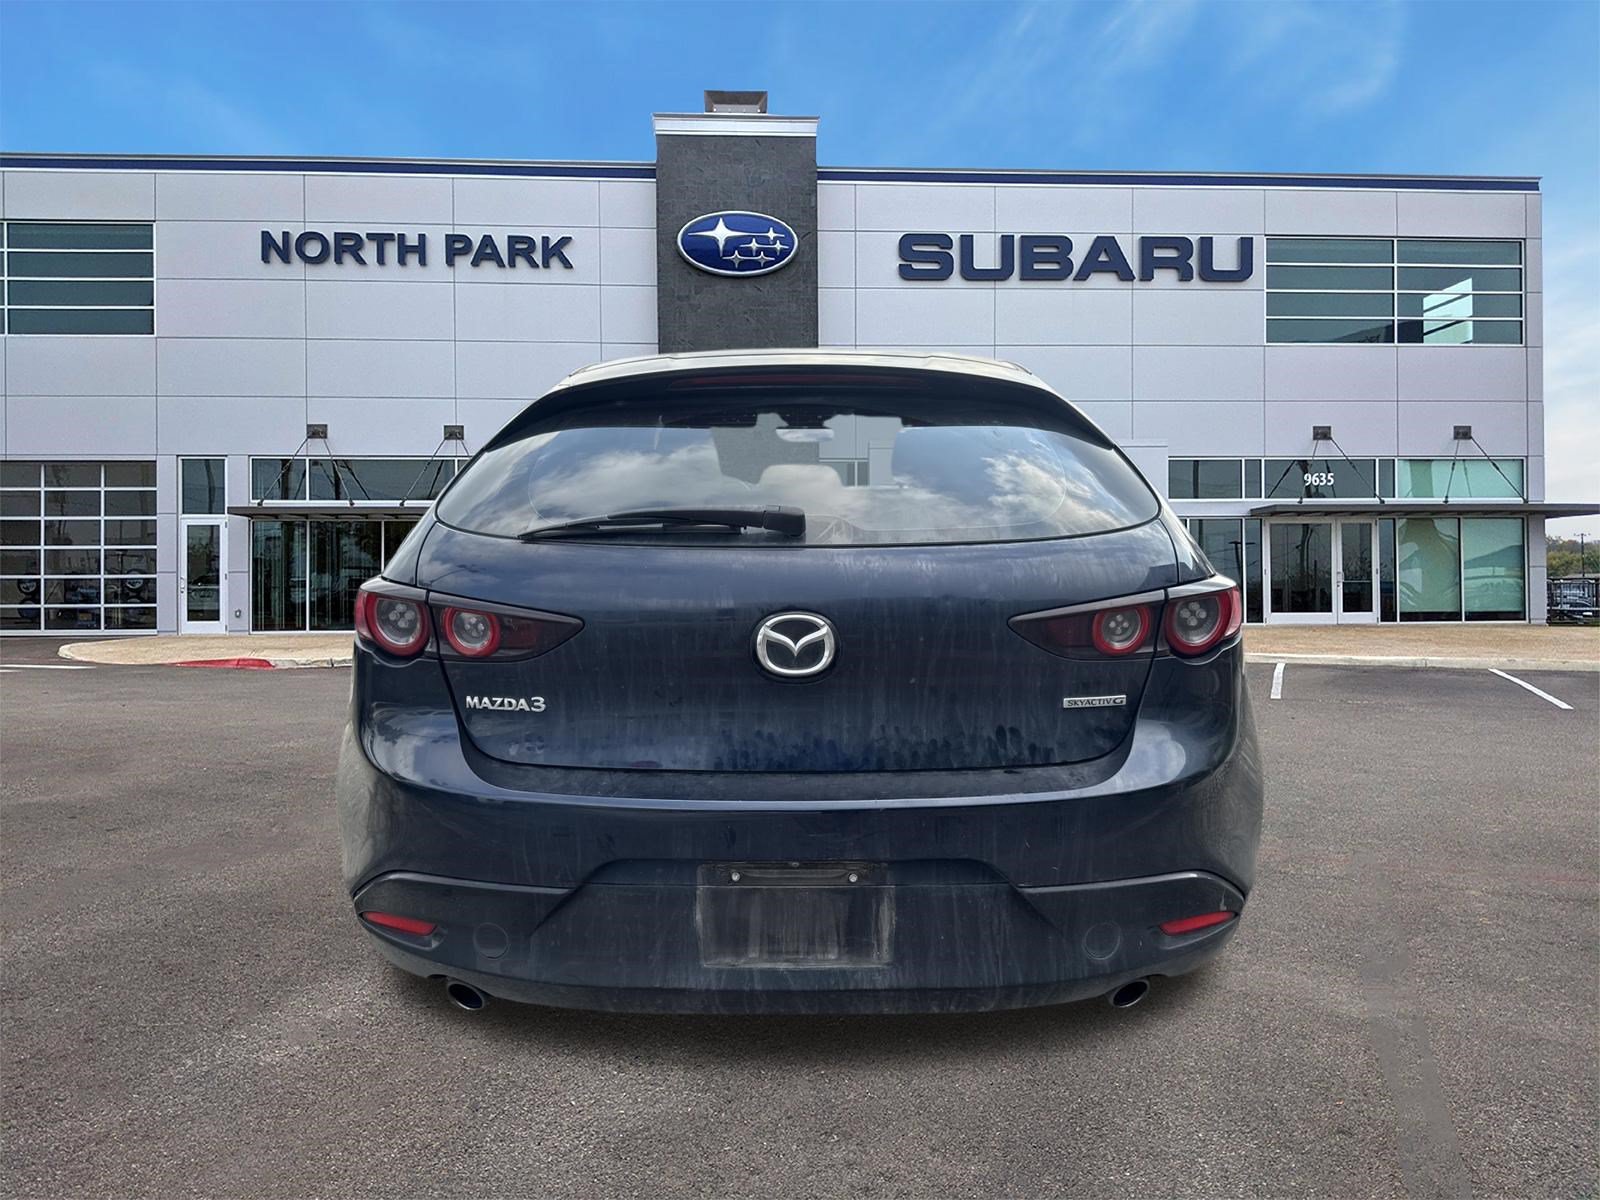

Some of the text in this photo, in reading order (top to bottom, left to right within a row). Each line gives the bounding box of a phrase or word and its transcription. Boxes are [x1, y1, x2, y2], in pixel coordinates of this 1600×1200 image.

[260, 230, 574, 269] NORTH PARK
[898, 233, 1254, 282] SUBARU
[1303, 472, 1335, 486] 9635
